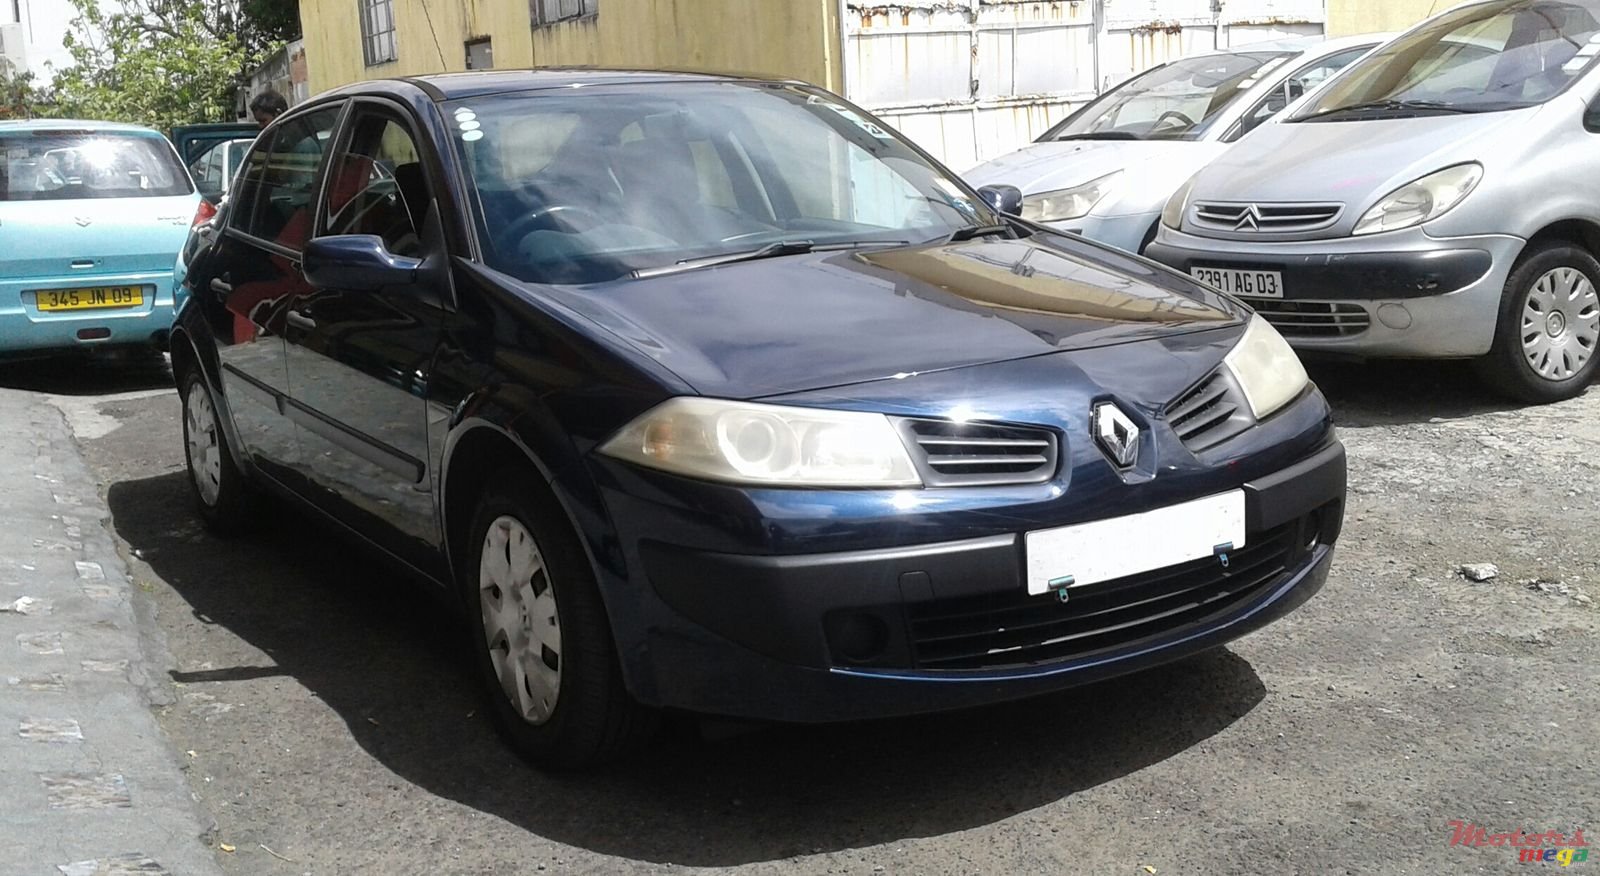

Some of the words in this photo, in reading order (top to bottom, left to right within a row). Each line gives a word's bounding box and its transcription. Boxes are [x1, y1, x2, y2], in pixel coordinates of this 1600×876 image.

[1235, 272, 1253, 293] AG
[1257, 273, 1276, 294] 03
[48, 290, 79, 307] 345
[87, 288, 106, 305] JN
[112, 287, 132, 303] 09
